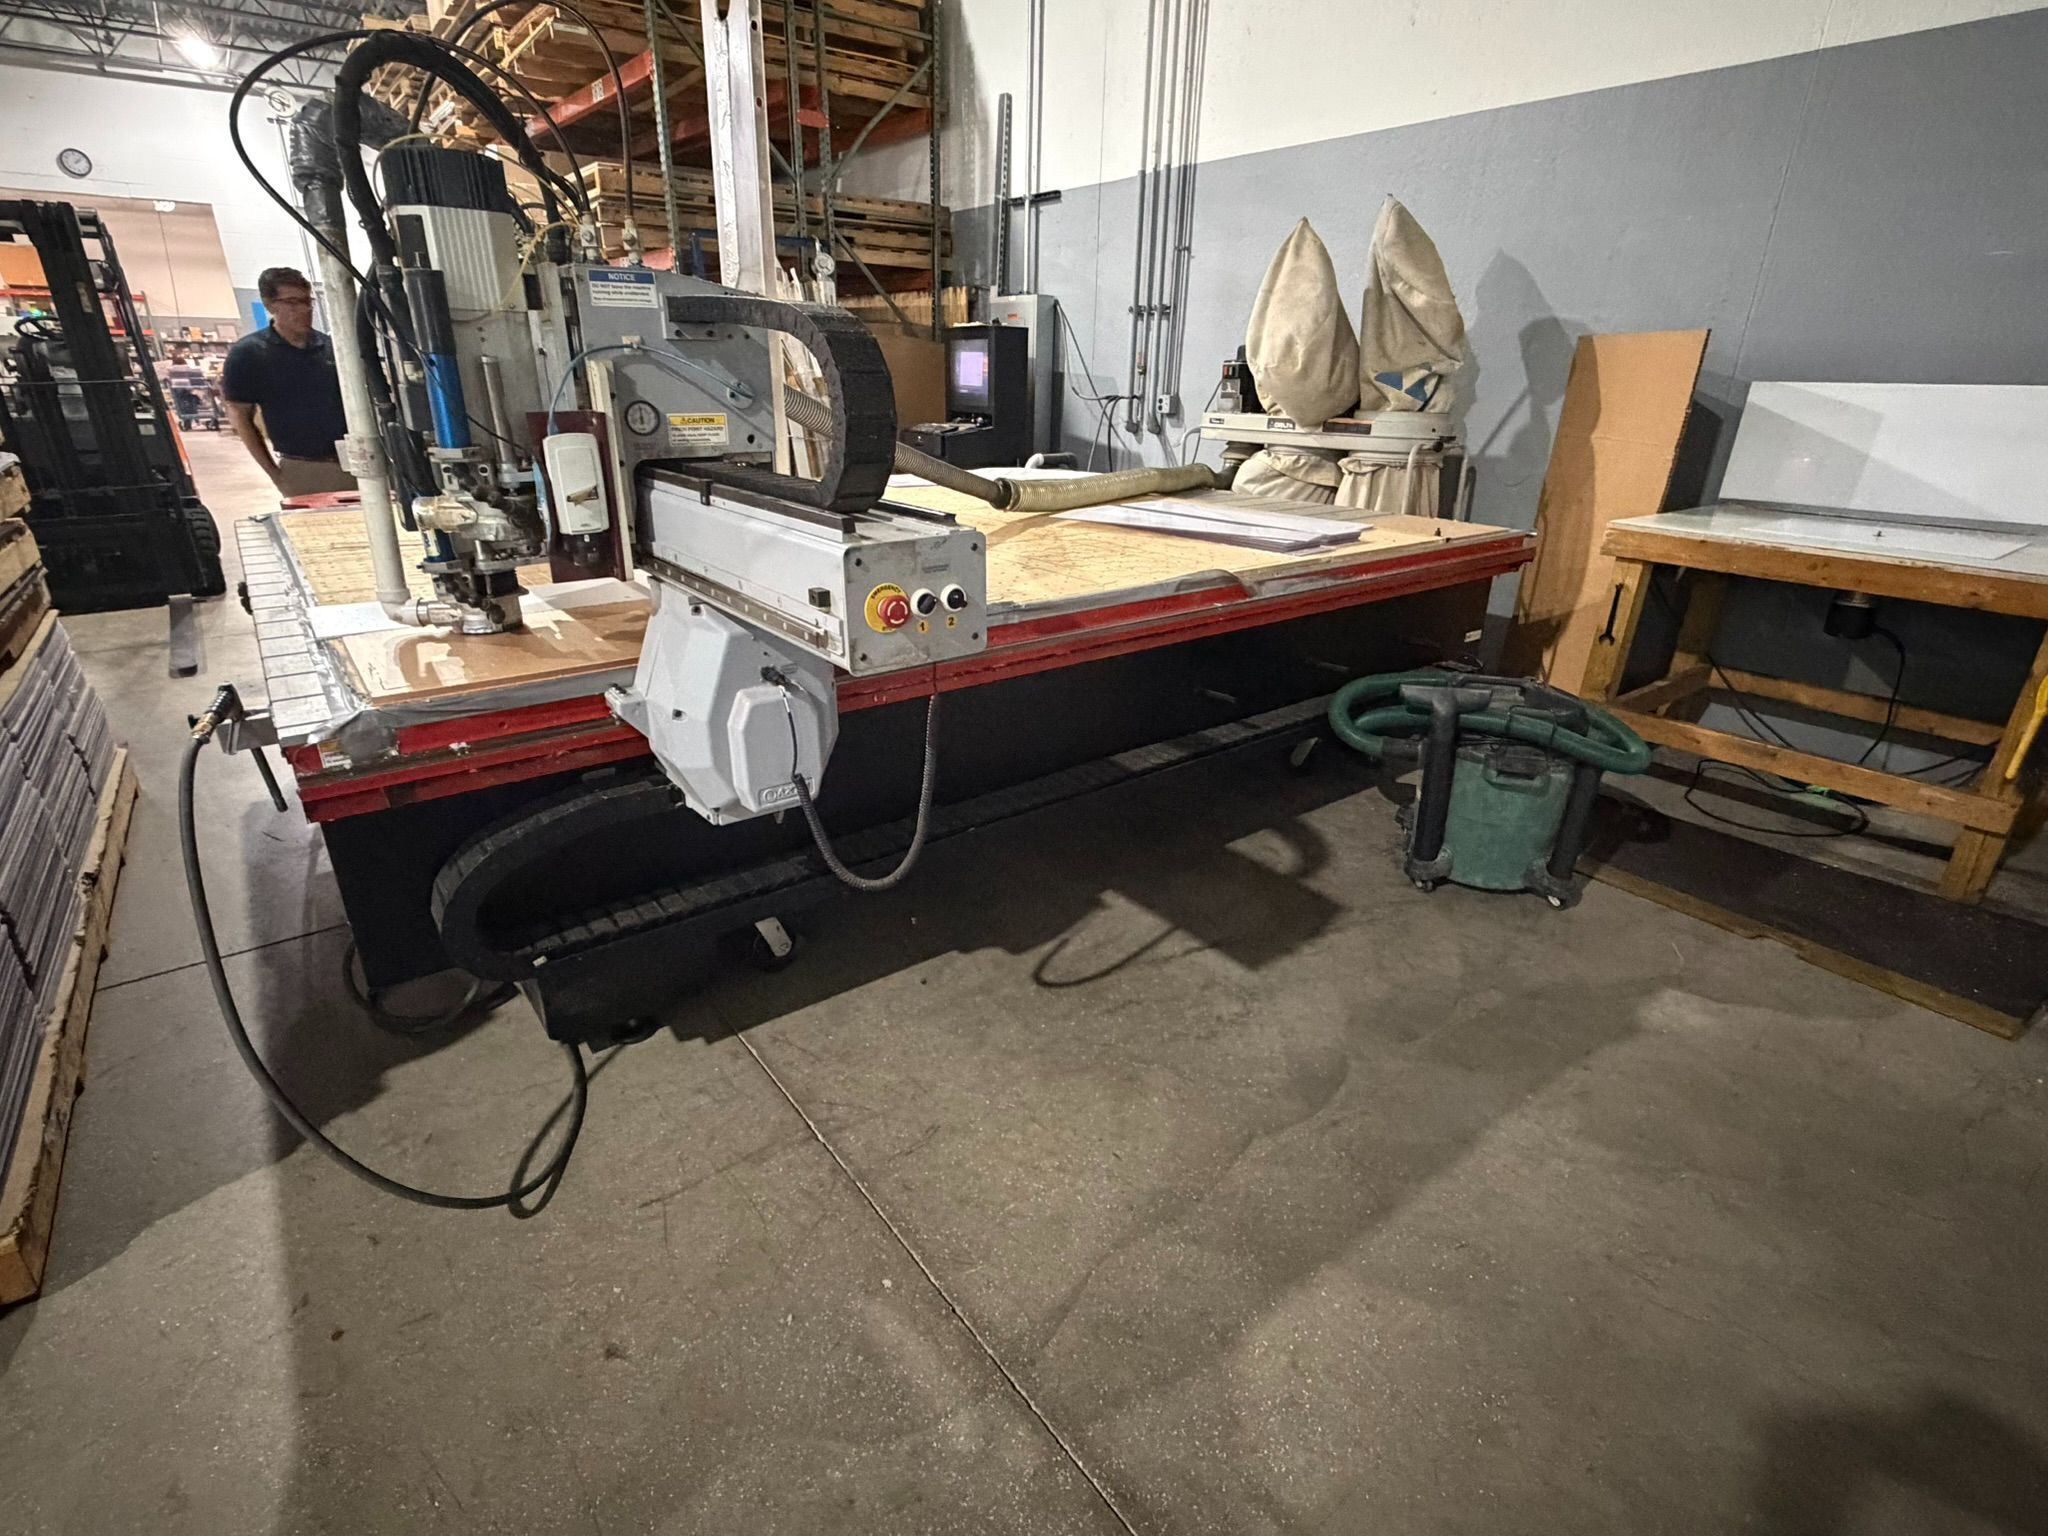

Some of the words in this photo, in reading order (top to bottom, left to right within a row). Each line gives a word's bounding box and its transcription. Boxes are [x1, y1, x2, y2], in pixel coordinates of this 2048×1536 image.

[608, 273, 636, 281] NOTICE
[871, 584, 902, 599] EMERGENCY
[948, 617, 954, 626] 2
